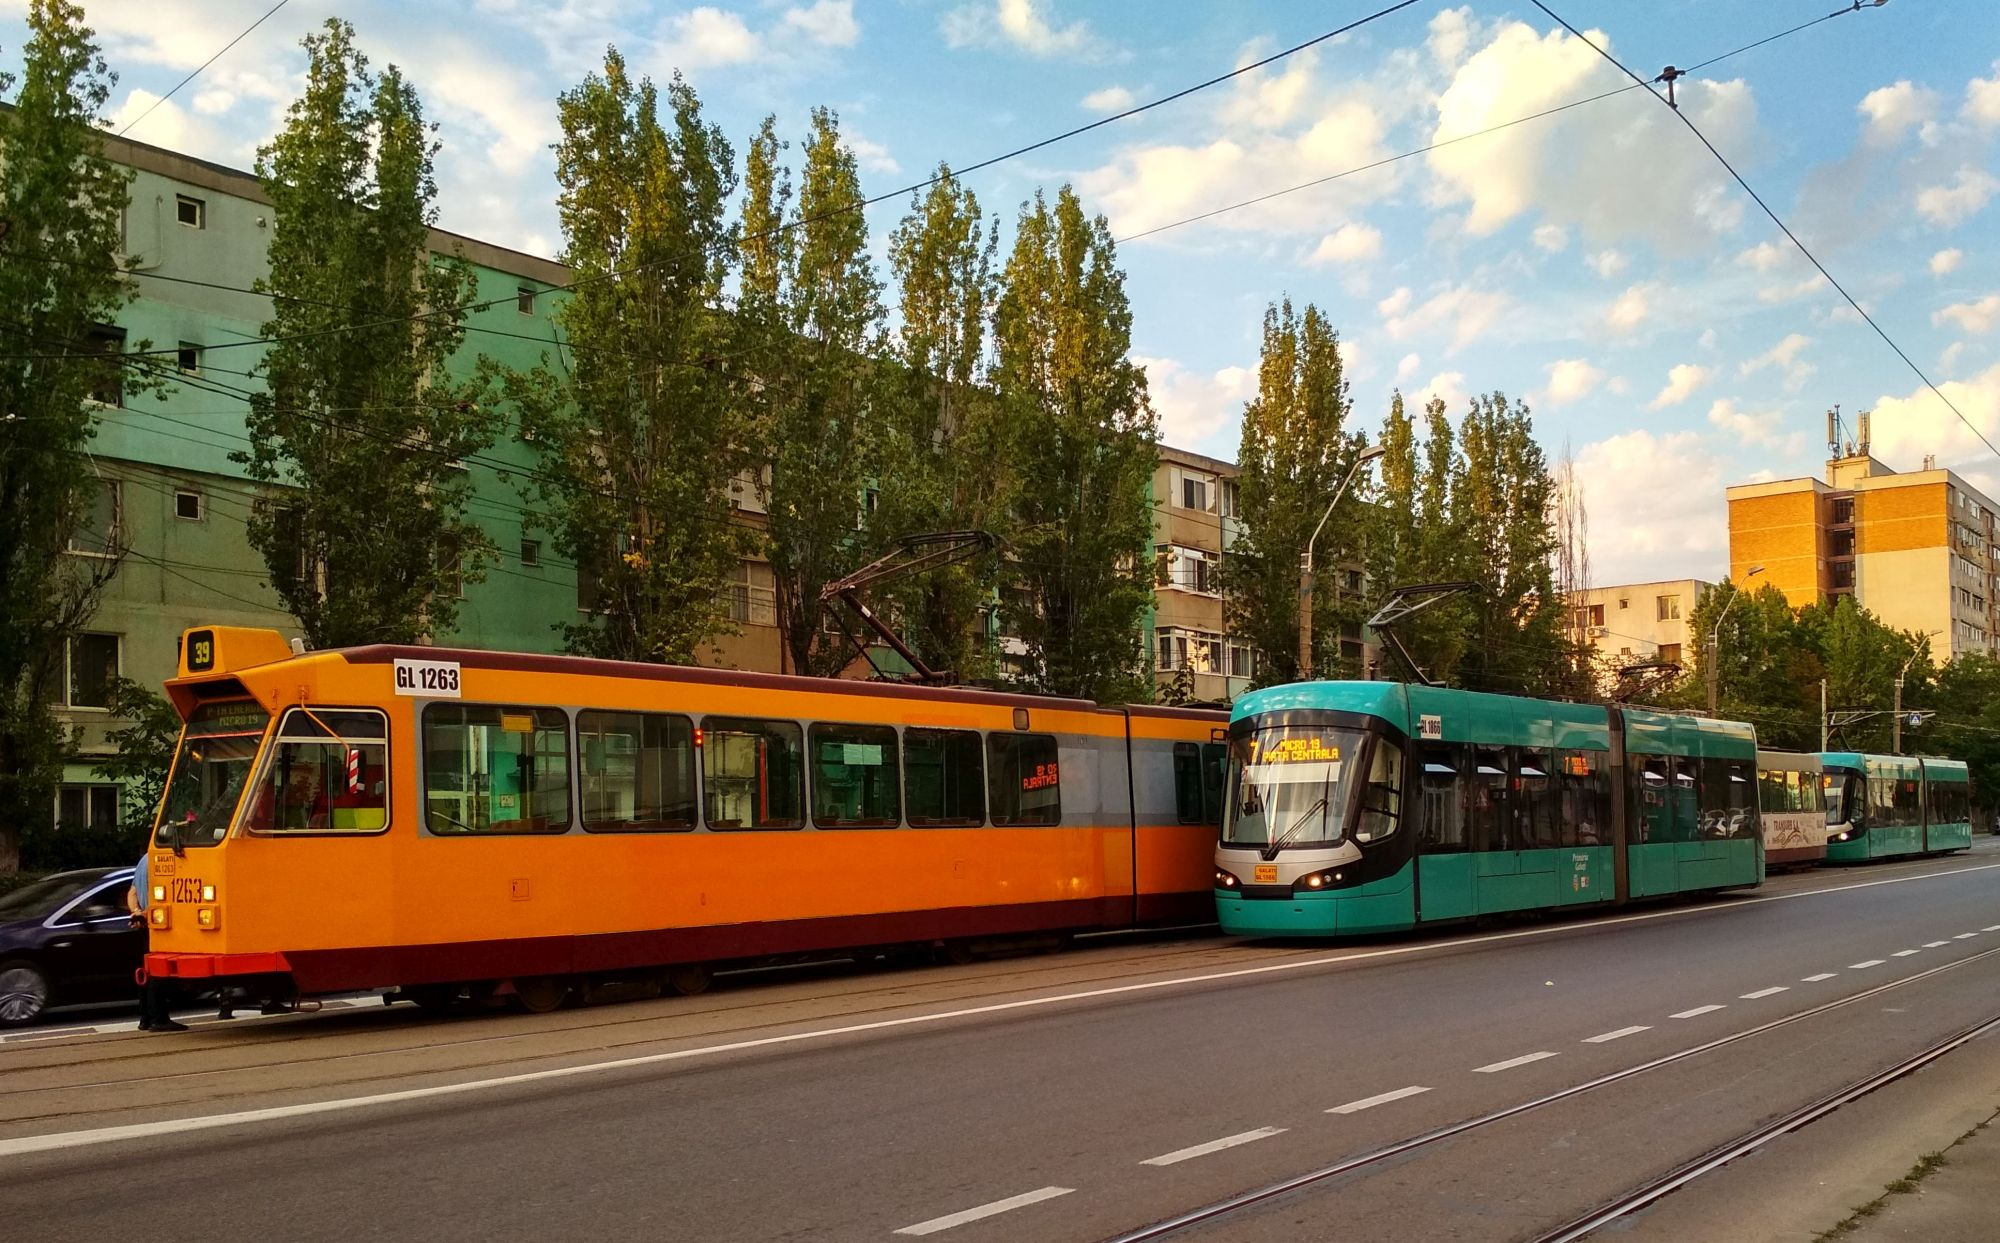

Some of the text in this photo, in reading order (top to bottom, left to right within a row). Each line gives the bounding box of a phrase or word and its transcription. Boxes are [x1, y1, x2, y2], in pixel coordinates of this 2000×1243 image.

[195, 641, 210, 664] 39
[396, 665, 459, 691] GL 1263
[1280, 739, 1307, 752] MICRO
[1291, 747, 1339, 761] CENTRALA
[171, 877, 202, 904] 1263
